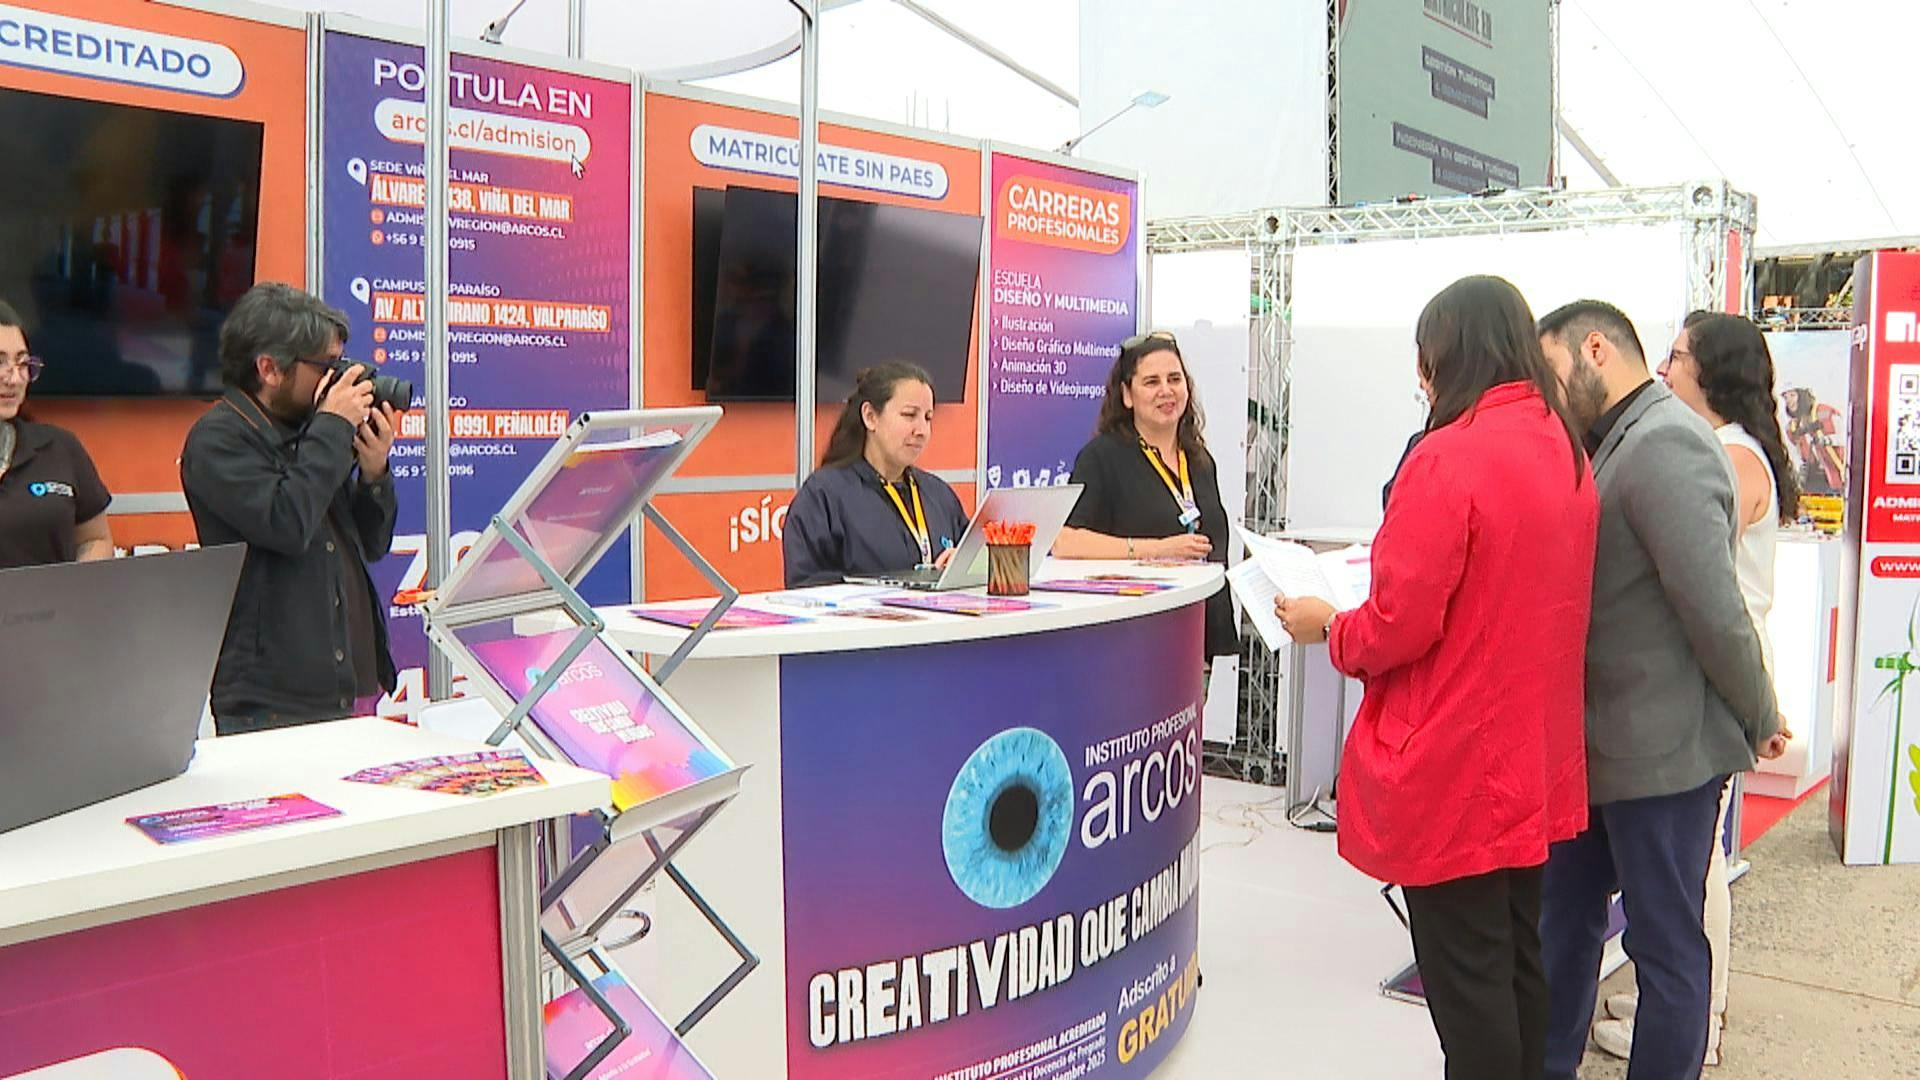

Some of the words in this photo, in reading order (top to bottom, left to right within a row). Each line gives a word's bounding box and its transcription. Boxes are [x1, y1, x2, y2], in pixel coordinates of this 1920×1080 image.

[374, 58, 542, 112] POTULA
[548, 86, 592, 119] EN
[392, 111, 576, 153] arcs.cl/admision
[370, 160, 403, 174] SEDE
[405, 161, 425, 176] VIÑ
[462, 172, 489, 184] MAR
[709, 135, 849, 175] MATRICÚATE
[855, 159, 883, 180] SIN
[890, 165, 933, 188] PAES
[371, 174, 425, 204] ÁLVARE
[449, 187, 476, 213] 138,
[478, 187, 510, 214] VIÑA
[513, 194, 537, 217] DEL
[539, 196, 570, 221] MAR
[1008, 184, 1120, 226] CARRERAS
[386, 233, 407, 245] +56
[409, 233, 418, 245] 9
[1008, 213, 1119, 245] PROFESIONALES
[373, 279, 425, 292] CAMPUS
[449, 283, 500, 297] PARAÍSO
[994, 269, 1042, 289] ESCUELA
[374, 297, 399, 320] AV.
[401, 298, 491, 324] ALTIRANO
[493, 304, 530, 328] 1424,
[533, 305, 608, 330] VALPARAÍSO
[994, 285, 1040, 307] DISEÑO
[1044, 293, 1051, 308] Y
[1055, 294, 1128, 316] MULTIMEDIA
[1002, 315, 1053, 333] Ilustración
[389, 349, 410, 361] +56
[412, 350, 420, 362] 9
[451, 351, 477, 363] 0915
[1002, 337, 1034, 353] Diseño
[1037, 337, 1072, 356] Gráfico
[1074, 341, 1121, 358] Multimedi
[1001, 357, 1051, 374] Animación
[1053, 361, 1067, 374] 3D
[1001, 379, 1033, 395] Diseño
[1035, 381, 1047, 395] de
[1050, 382, 1106, 399] Videojuegos
[454, 415, 491, 438] 8991,
[495, 411, 567, 436] PEÑALOLÉN
[389, 444, 517, 457] ADMIS@ARCOS.CL
[394, 465, 409, 477] 56
[411, 465, 419, 477] 9
[1873, 497, 1920, 509] ADMI
[1085, 727, 1150, 768] INSTITUTO
[1151, 702, 1197, 745] PROFESIONAL
[1081, 728, 1197, 849] arcos
[809, 913, 1075, 1048] CREATIVIDAD
[1080, 893, 1128, 967] QUE
[1131, 860, 1179, 942] CAMBIA
[1118, 961, 1168, 1015] Adscrito
[1169, 954, 1176, 974] a
[993, 1035, 1058, 1075] PROFESIONAL
[1058, 1011, 1107, 1046] ACREDITADO
[1033, 1057, 1067, 1078] Docencia
[1067, 1050, 1077, 1064] de
[1087, 1049, 1106, 1072] 2025
